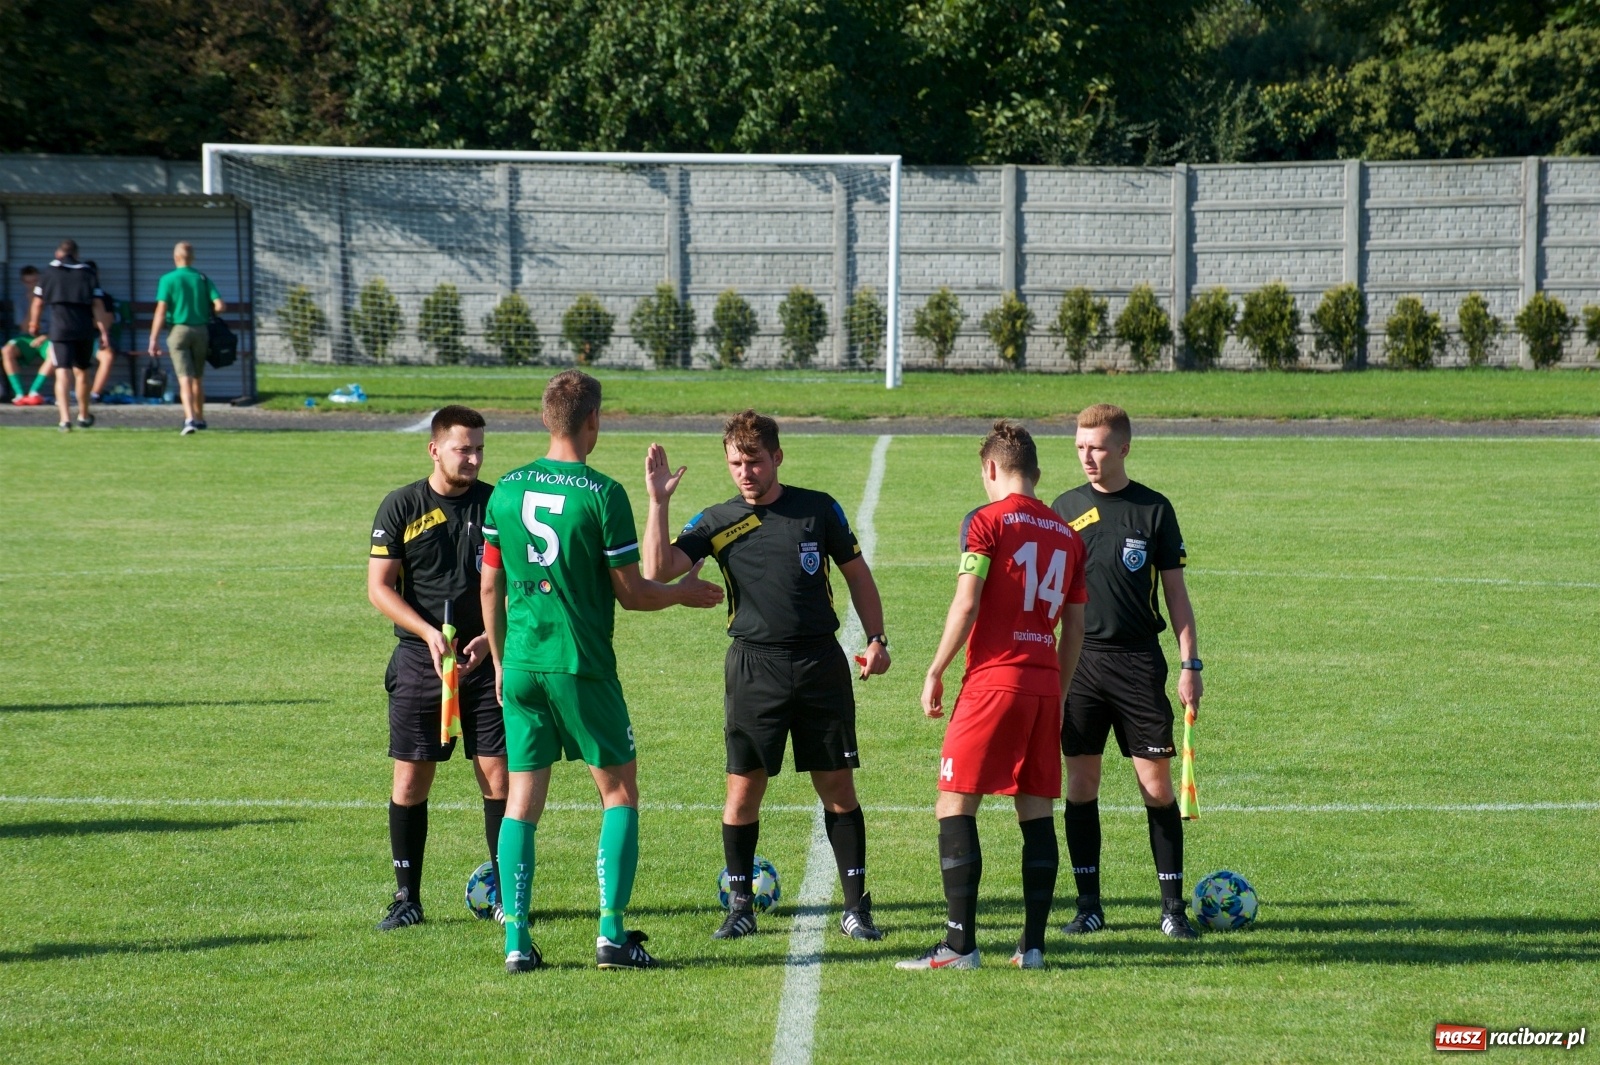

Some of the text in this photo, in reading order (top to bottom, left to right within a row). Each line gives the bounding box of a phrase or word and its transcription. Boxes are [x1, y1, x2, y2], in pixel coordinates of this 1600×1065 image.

[527, 470, 603, 493] TWORKÓW
[521, 489, 566, 567] 5
[1003, 511, 1038, 527] GRANICA
[725, 522, 750, 538] zina
[964, 553, 978, 571] C
[1012, 541, 1067, 619] 14
[1013, 629, 1055, 647] maxima-sp
